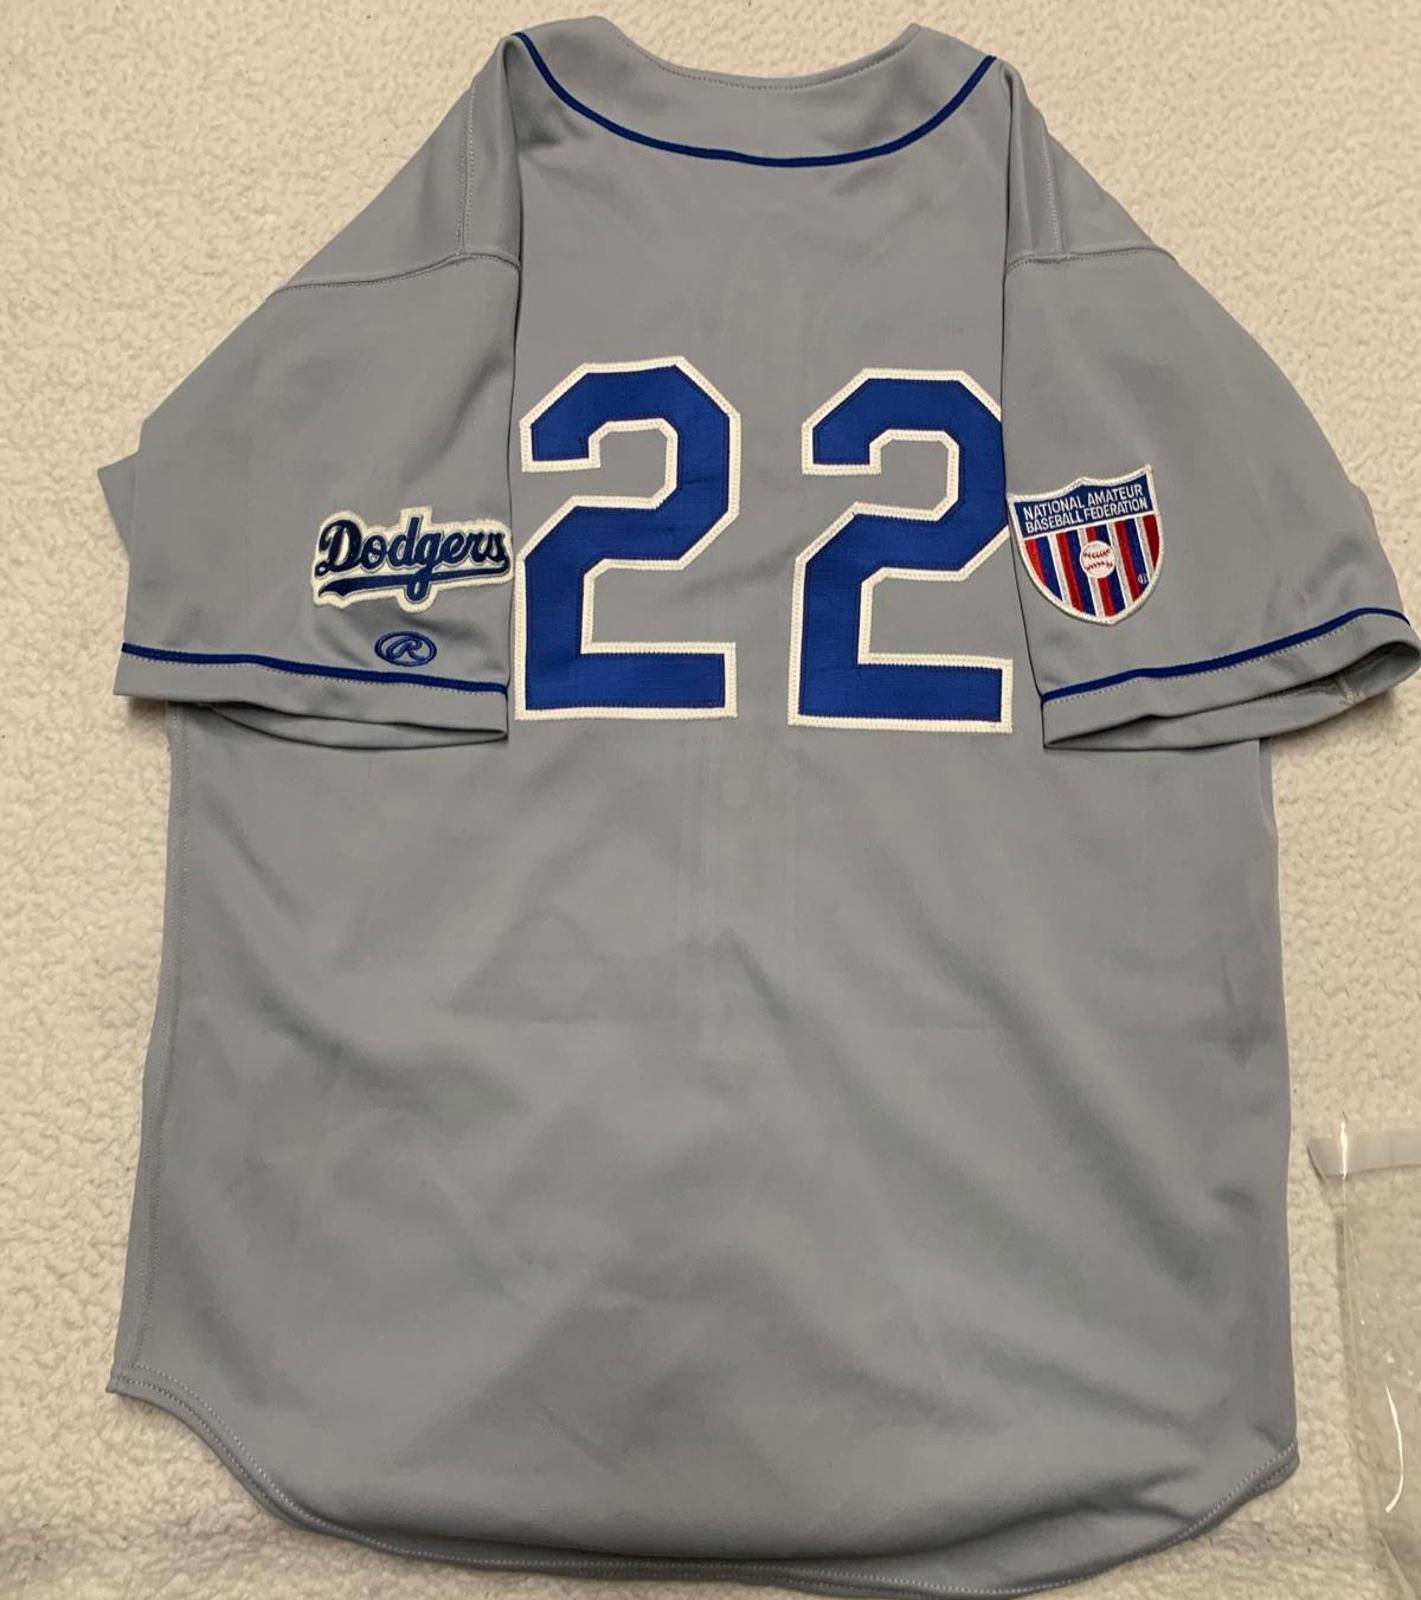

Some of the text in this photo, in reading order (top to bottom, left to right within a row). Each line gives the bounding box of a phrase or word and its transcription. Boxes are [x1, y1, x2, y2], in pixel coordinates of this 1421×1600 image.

[1024, 484, 1143, 520] NATIONAL AMATEUR
[1026, 498, 1148, 534] BASEBALL FEDERATION
[314, 516, 510, 602] Dodgers
[514, 355, 1013, 733] 22
